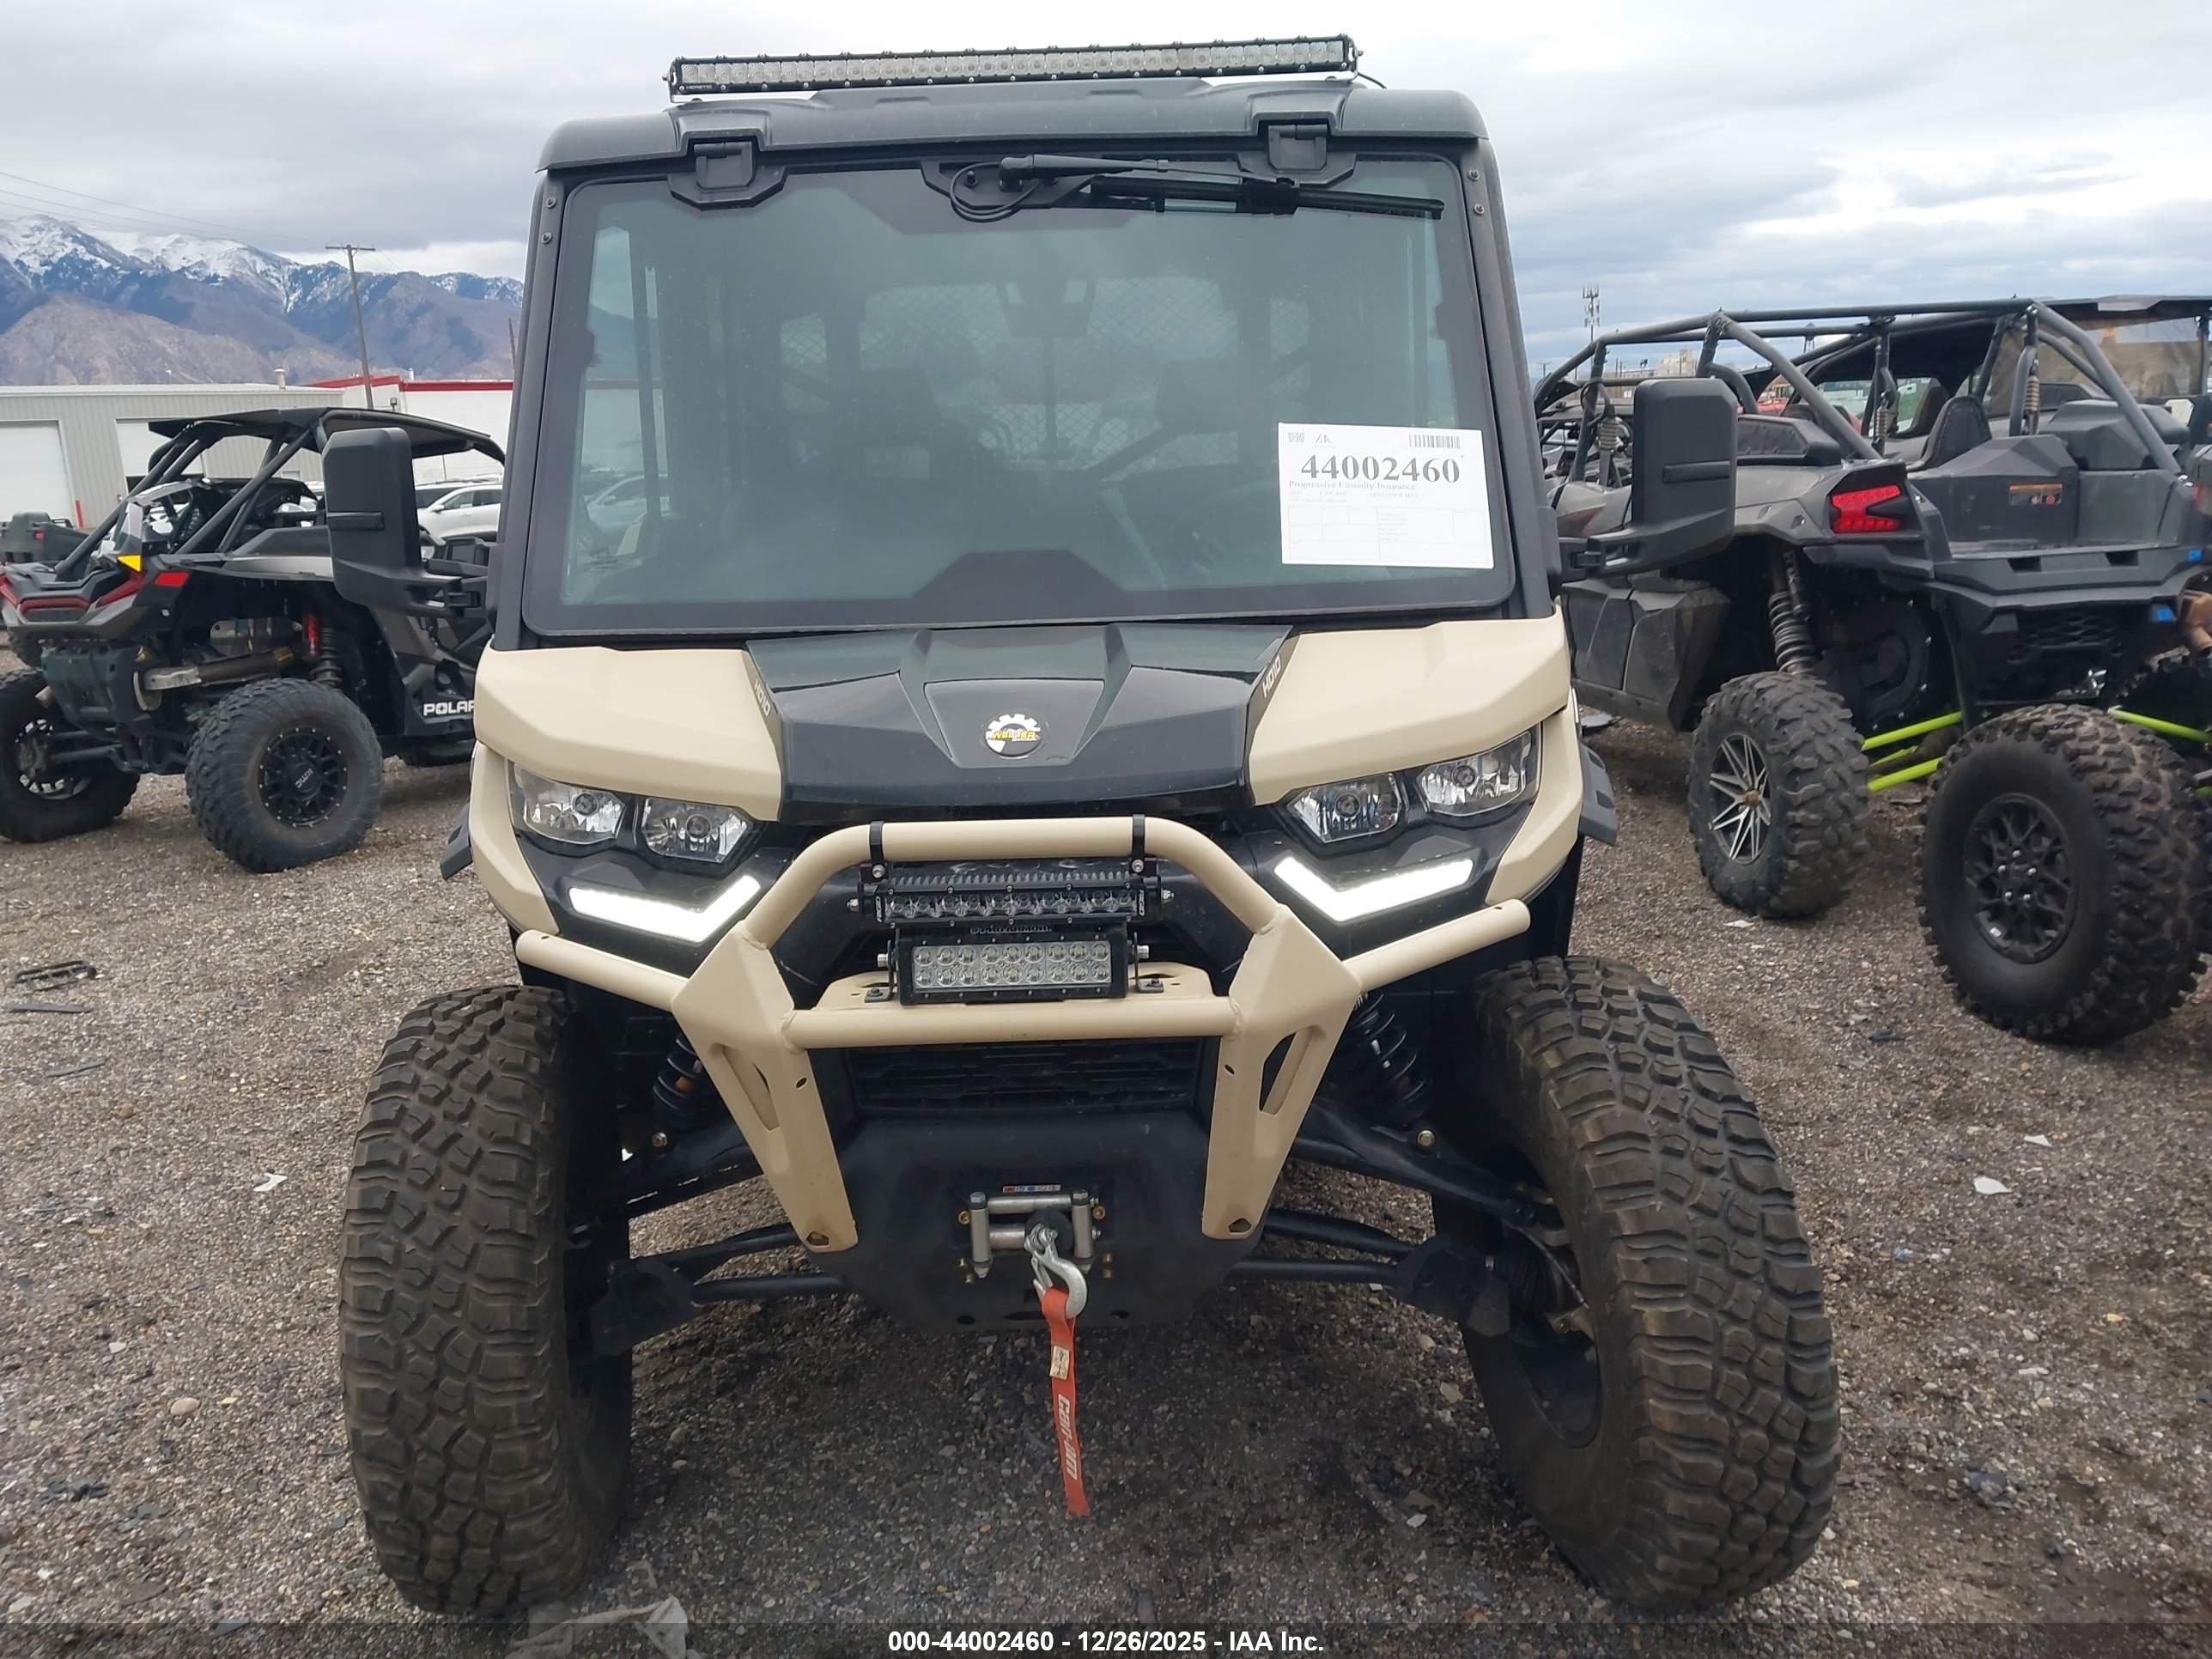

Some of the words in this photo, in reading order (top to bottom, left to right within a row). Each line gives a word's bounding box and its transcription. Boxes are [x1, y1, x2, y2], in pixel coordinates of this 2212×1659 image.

[1301, 454, 1460, 483] 44002460
[1289, 480, 1336, 490] Progressive
[1377, 483, 1416, 491] Insurance
[1262, 653, 1281, 699] HD10
[754, 678, 771, 716] HD10
